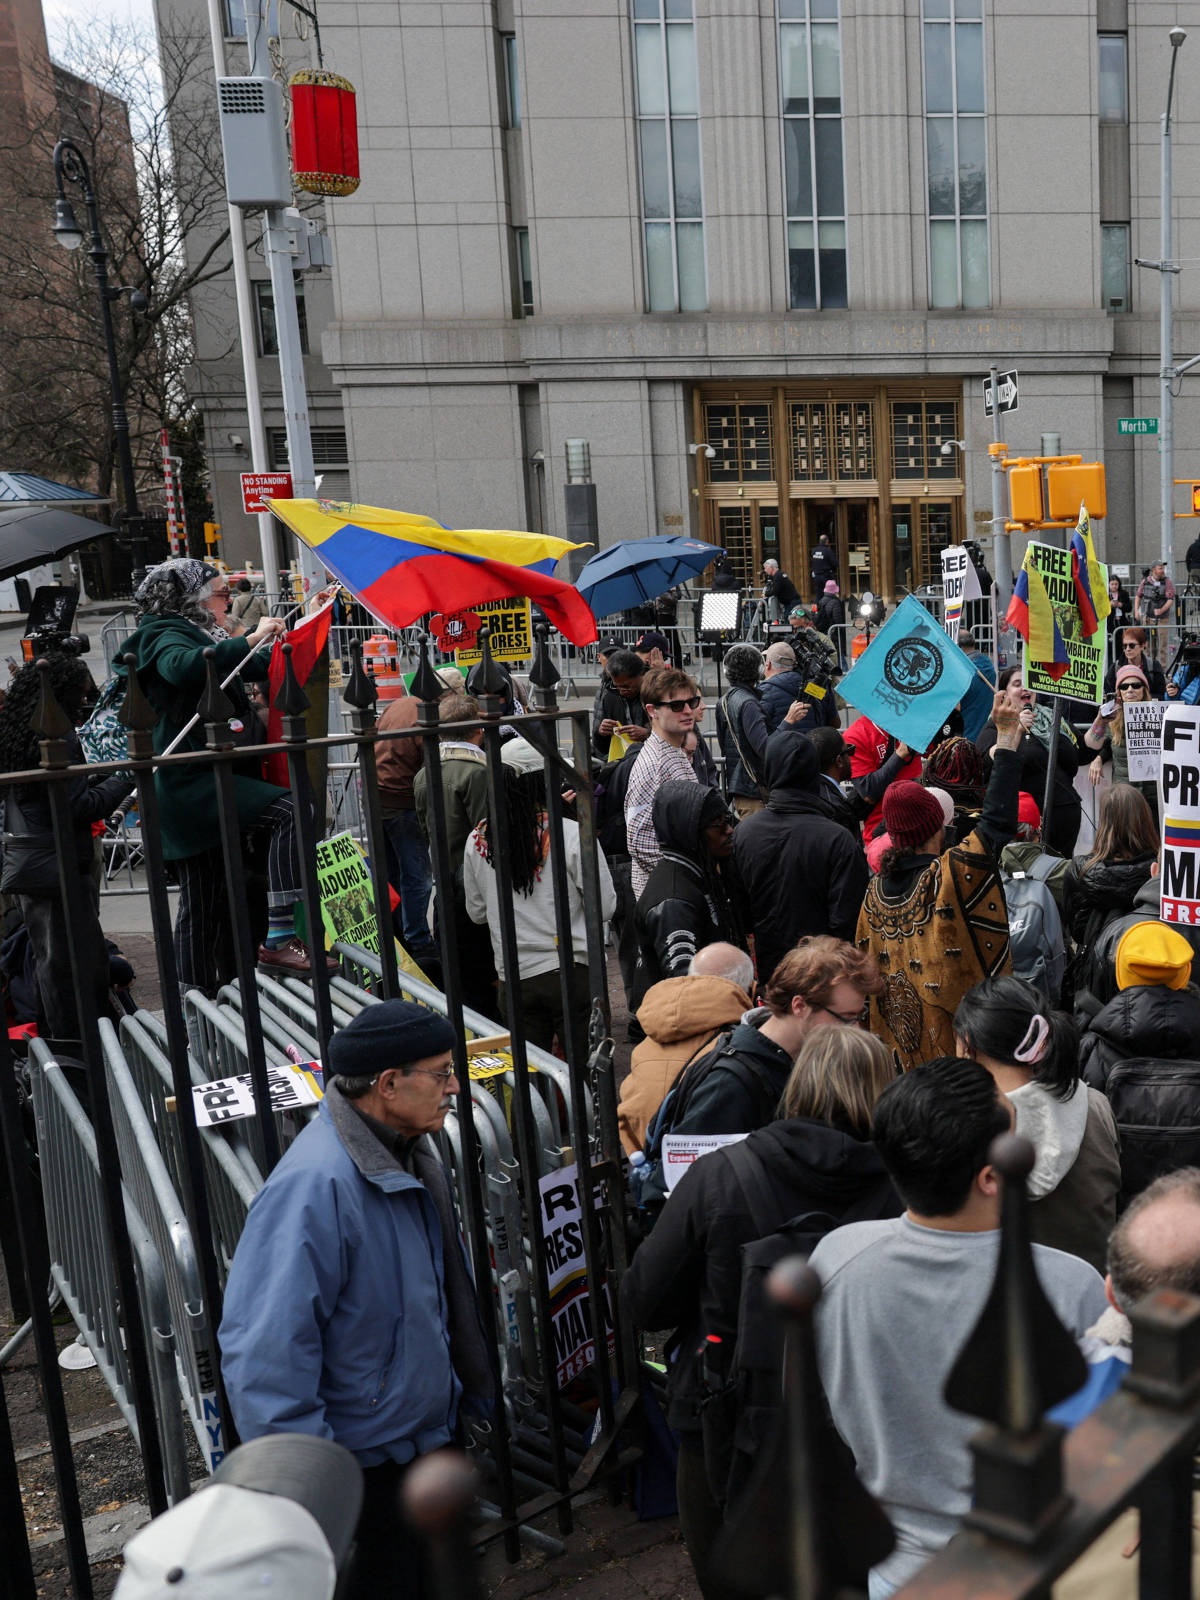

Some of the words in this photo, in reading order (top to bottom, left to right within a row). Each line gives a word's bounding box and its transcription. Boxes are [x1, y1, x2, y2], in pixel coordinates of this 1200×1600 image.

[1120, 420, 1147, 432] Worth
[244, 477, 254, 485] NO
[255, 476, 288, 485] STANDING
[246, 486, 274, 496] Anytime
[1034, 545, 1068, 576] FREE
[1067, 660, 1097, 682] LORES
[1032, 682, 1059, 694] WORKERS
[1078, 689, 1095, 701] PARTY
[1129, 706, 1156, 714] HANDS
[1132, 713, 1164, 721] VENEZU
[1128, 722, 1144, 730] FREE
[1129, 730, 1155, 739] Maduro
[1129, 739, 1145, 747] FREE
